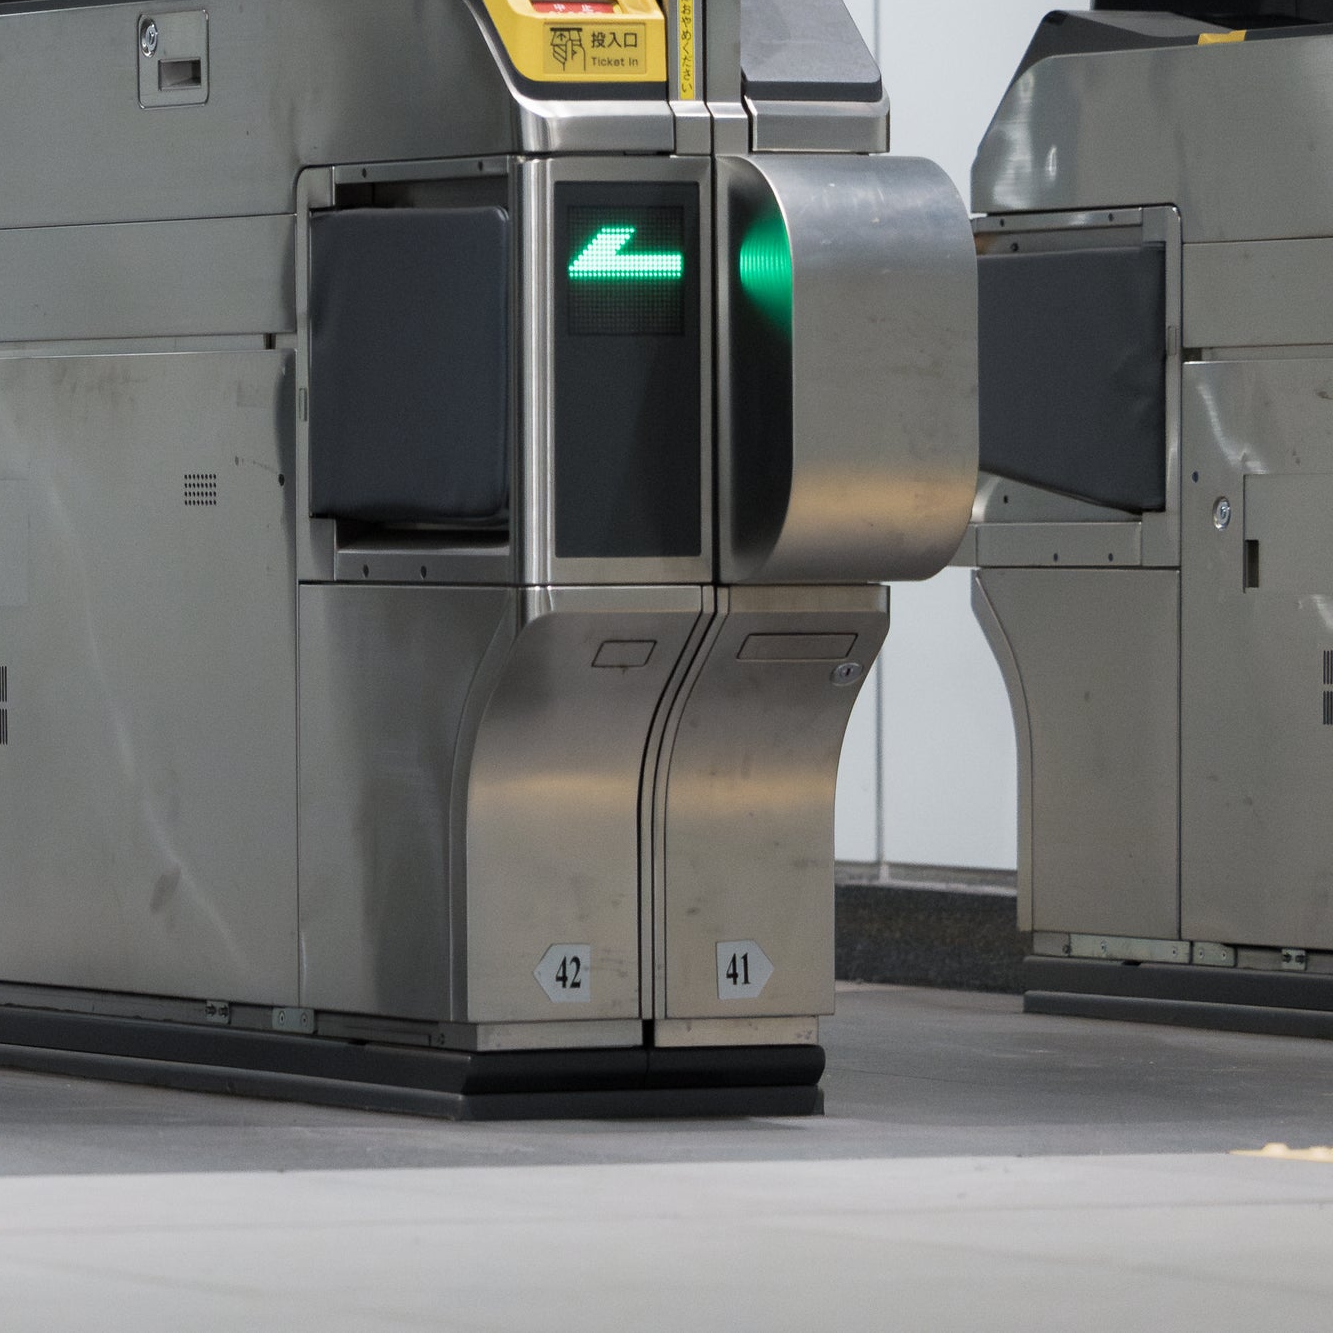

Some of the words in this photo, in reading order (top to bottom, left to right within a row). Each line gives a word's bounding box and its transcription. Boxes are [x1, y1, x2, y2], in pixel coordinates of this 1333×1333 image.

[590, 31, 639, 49] 投入口
[591, 56, 625, 67] Ticket
[628, 56, 639, 67] In
[555, 955, 582, 989] 42
[725, 952, 751, 986] 41
